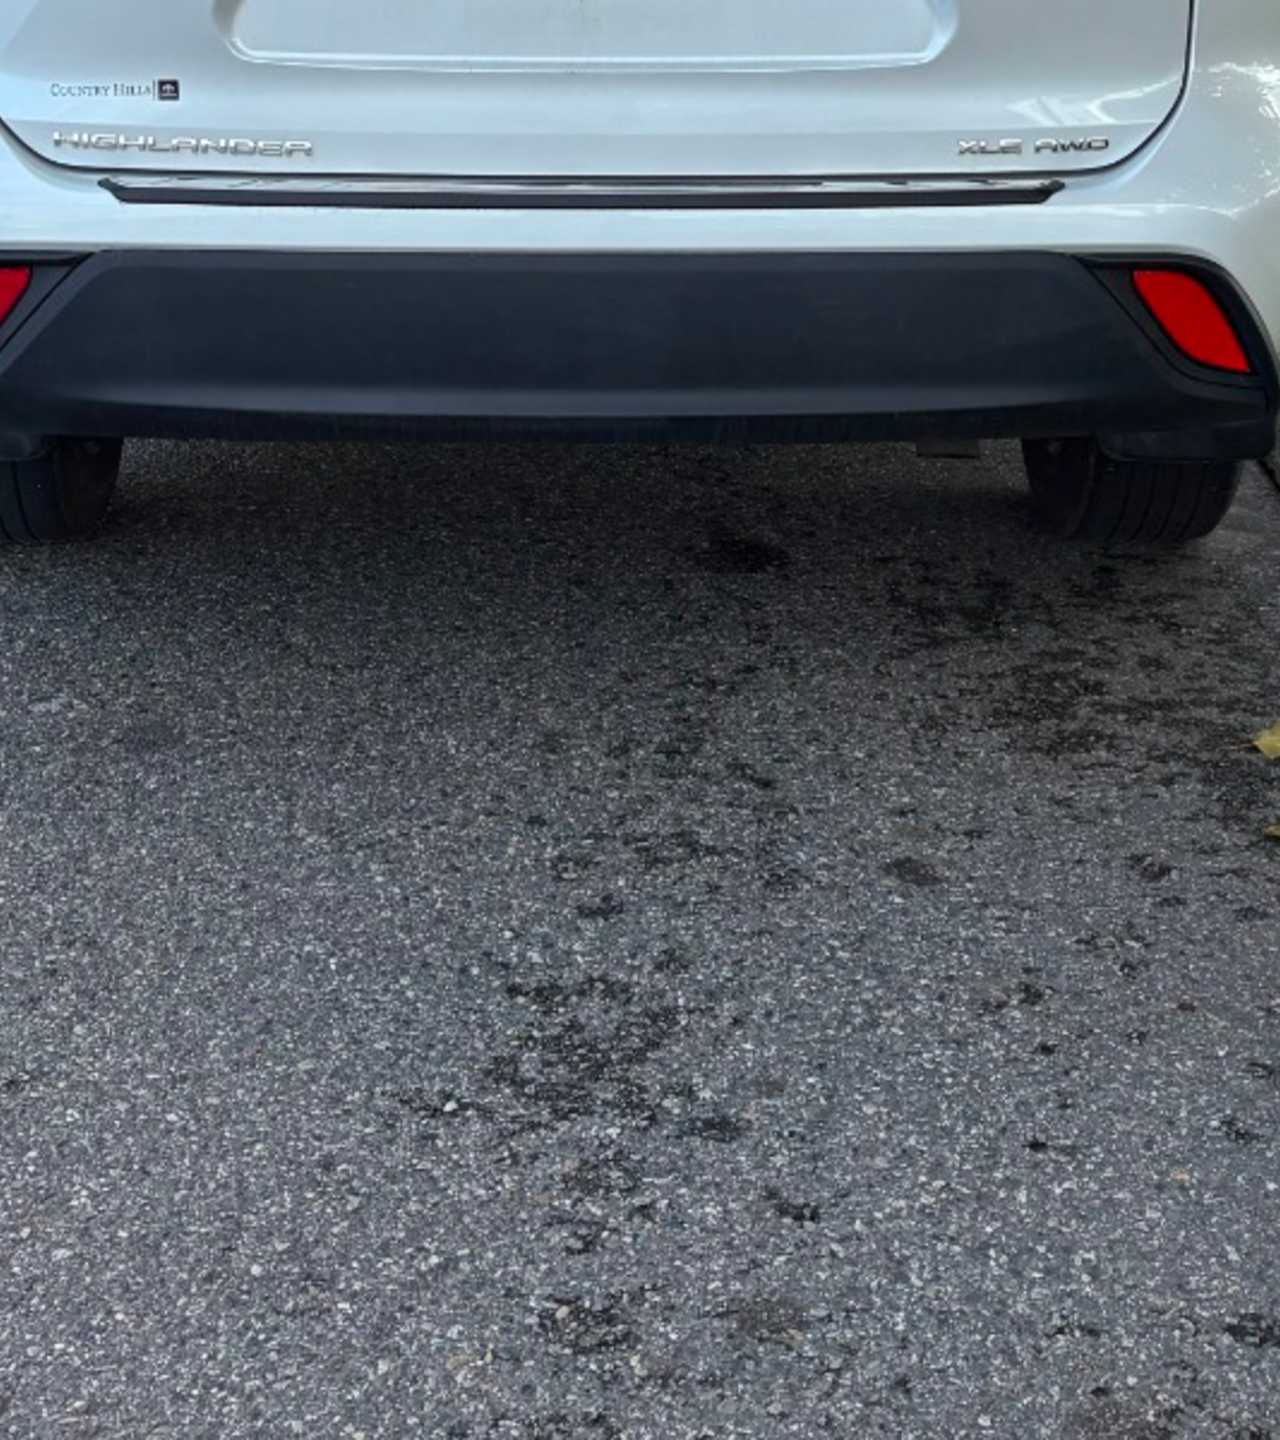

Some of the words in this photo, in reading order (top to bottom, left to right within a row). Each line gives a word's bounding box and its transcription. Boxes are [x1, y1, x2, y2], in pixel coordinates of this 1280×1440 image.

[51, 130, 314, 159] HIGHLANDER
[957, 138, 1023, 155] XLE
[1034, 136, 1110, 154] AWD
